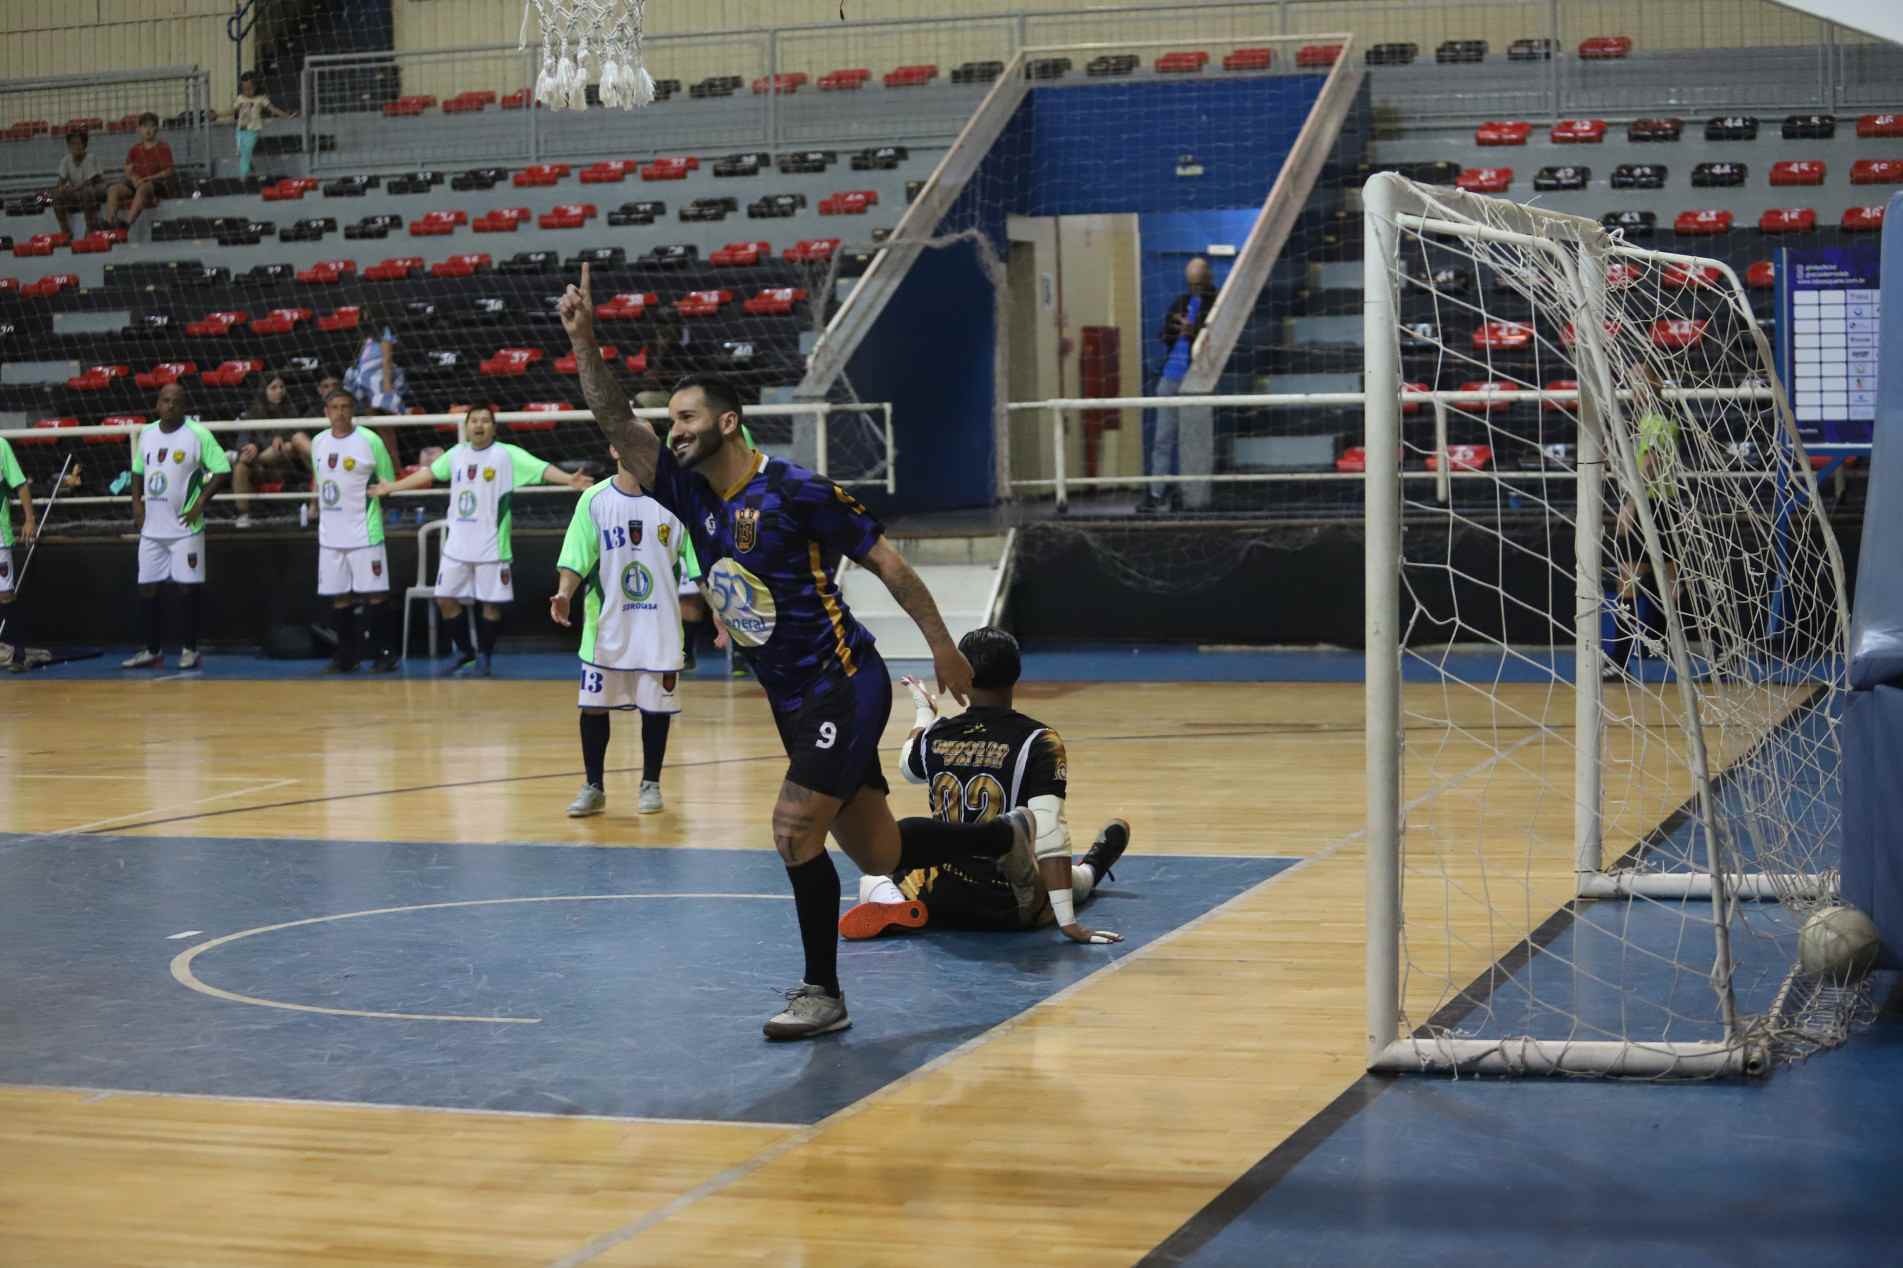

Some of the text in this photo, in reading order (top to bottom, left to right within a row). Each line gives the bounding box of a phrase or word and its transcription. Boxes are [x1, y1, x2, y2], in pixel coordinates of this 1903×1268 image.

[603, 526, 626, 551] 13
[580, 669, 604, 693] 13
[816, 721, 837, 749] 9
